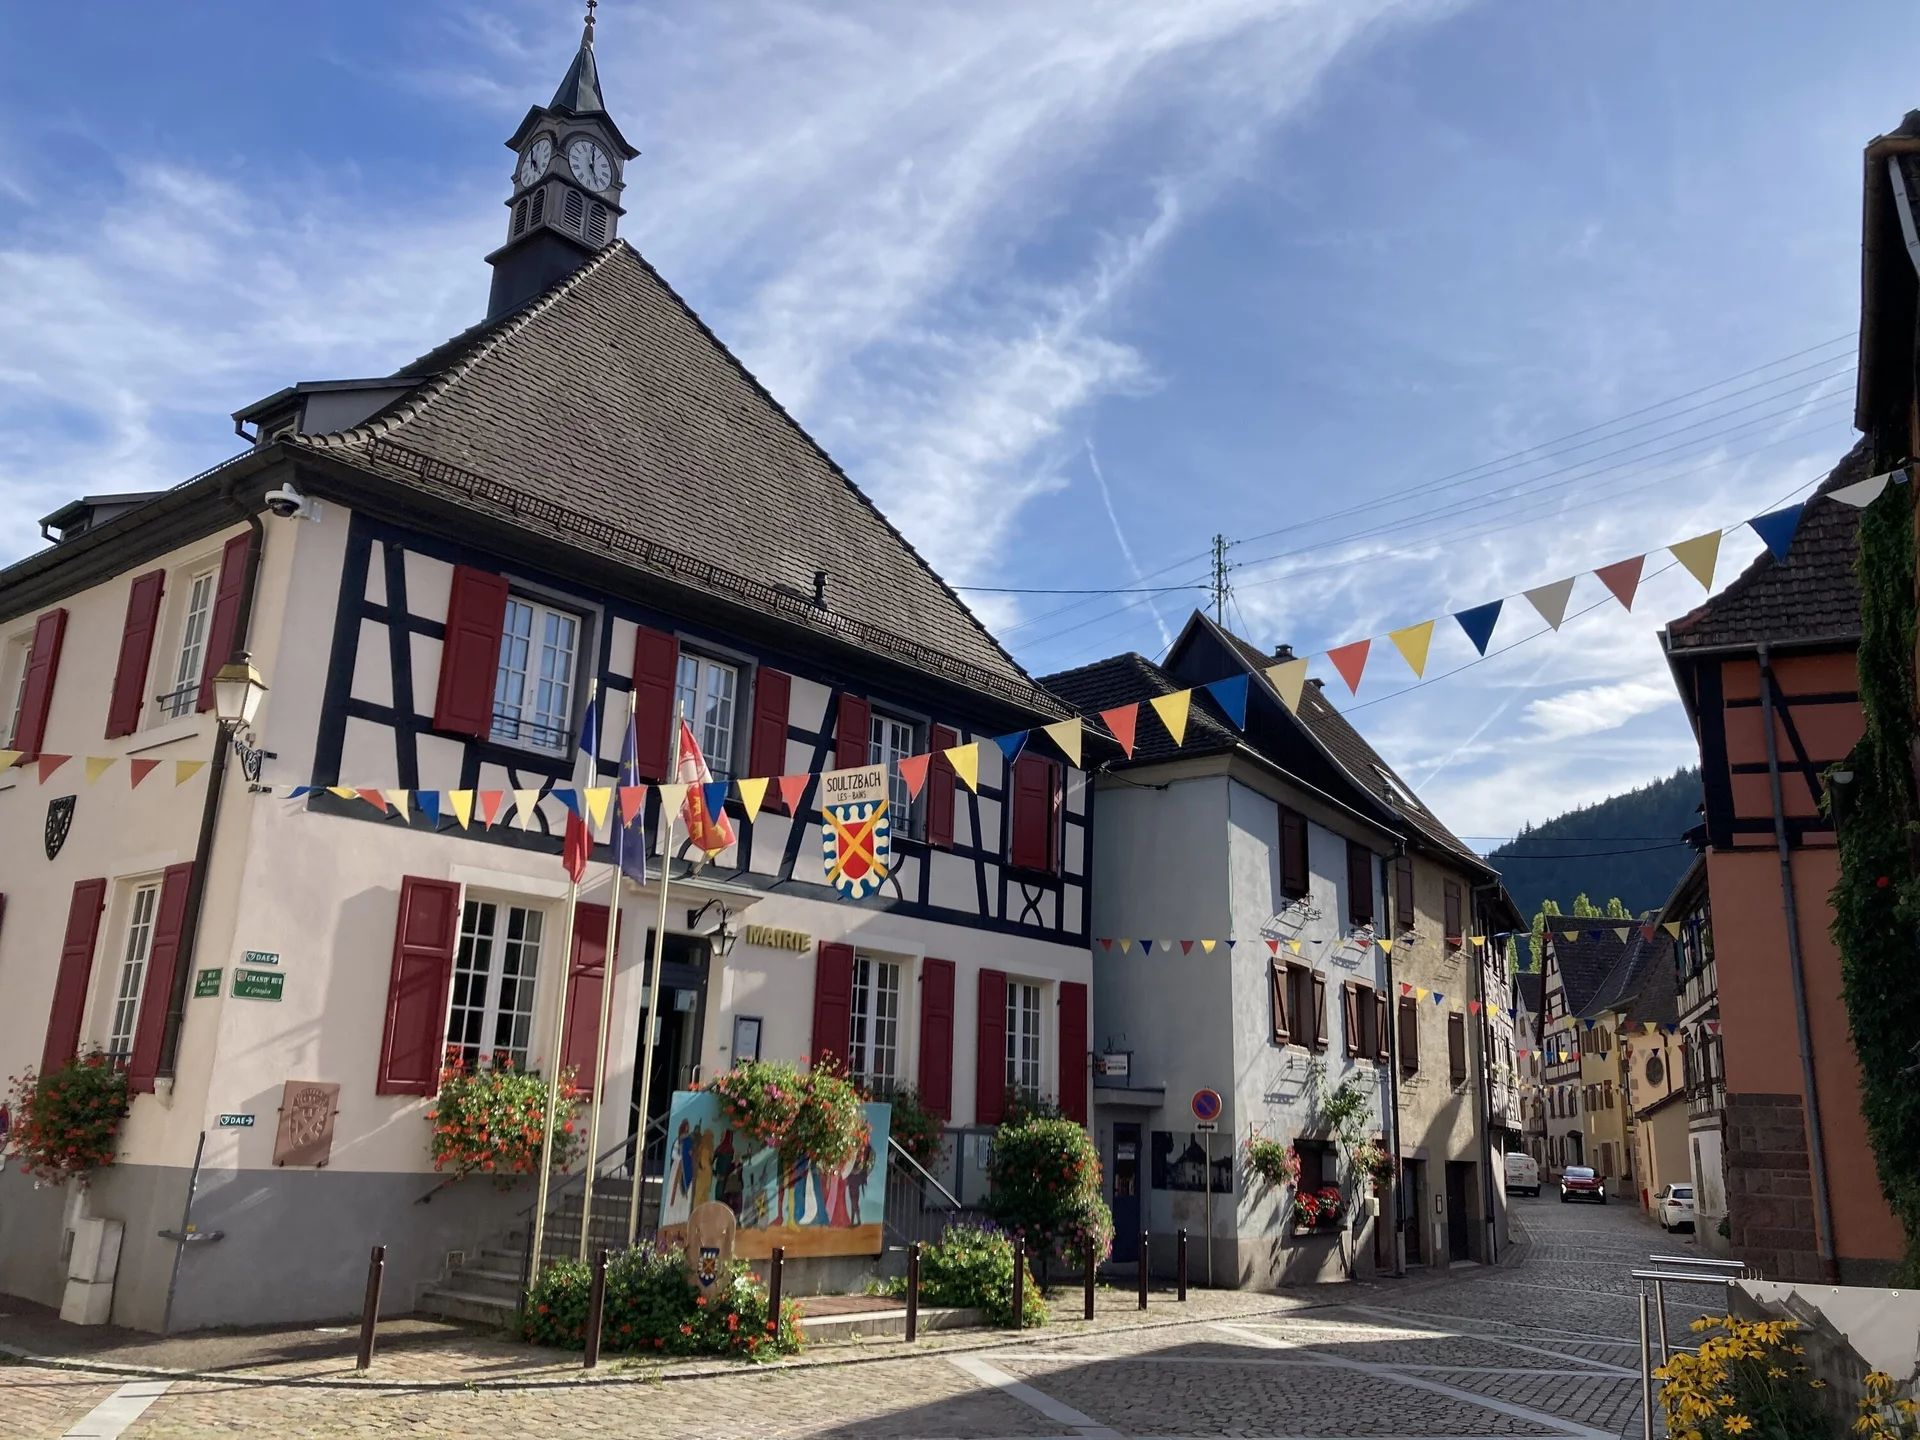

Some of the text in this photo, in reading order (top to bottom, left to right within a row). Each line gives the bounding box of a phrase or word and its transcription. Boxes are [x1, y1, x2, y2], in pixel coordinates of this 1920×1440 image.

[827, 772, 881, 792] SOULTZBACH
[837, 793, 848, 801] LES
[852, 790, 867, 800] BAINS
[746, 924, 812, 952] MAIRIE
[256, 954, 270, 962] DAE
[230, 1116, 245, 1125] DAE
